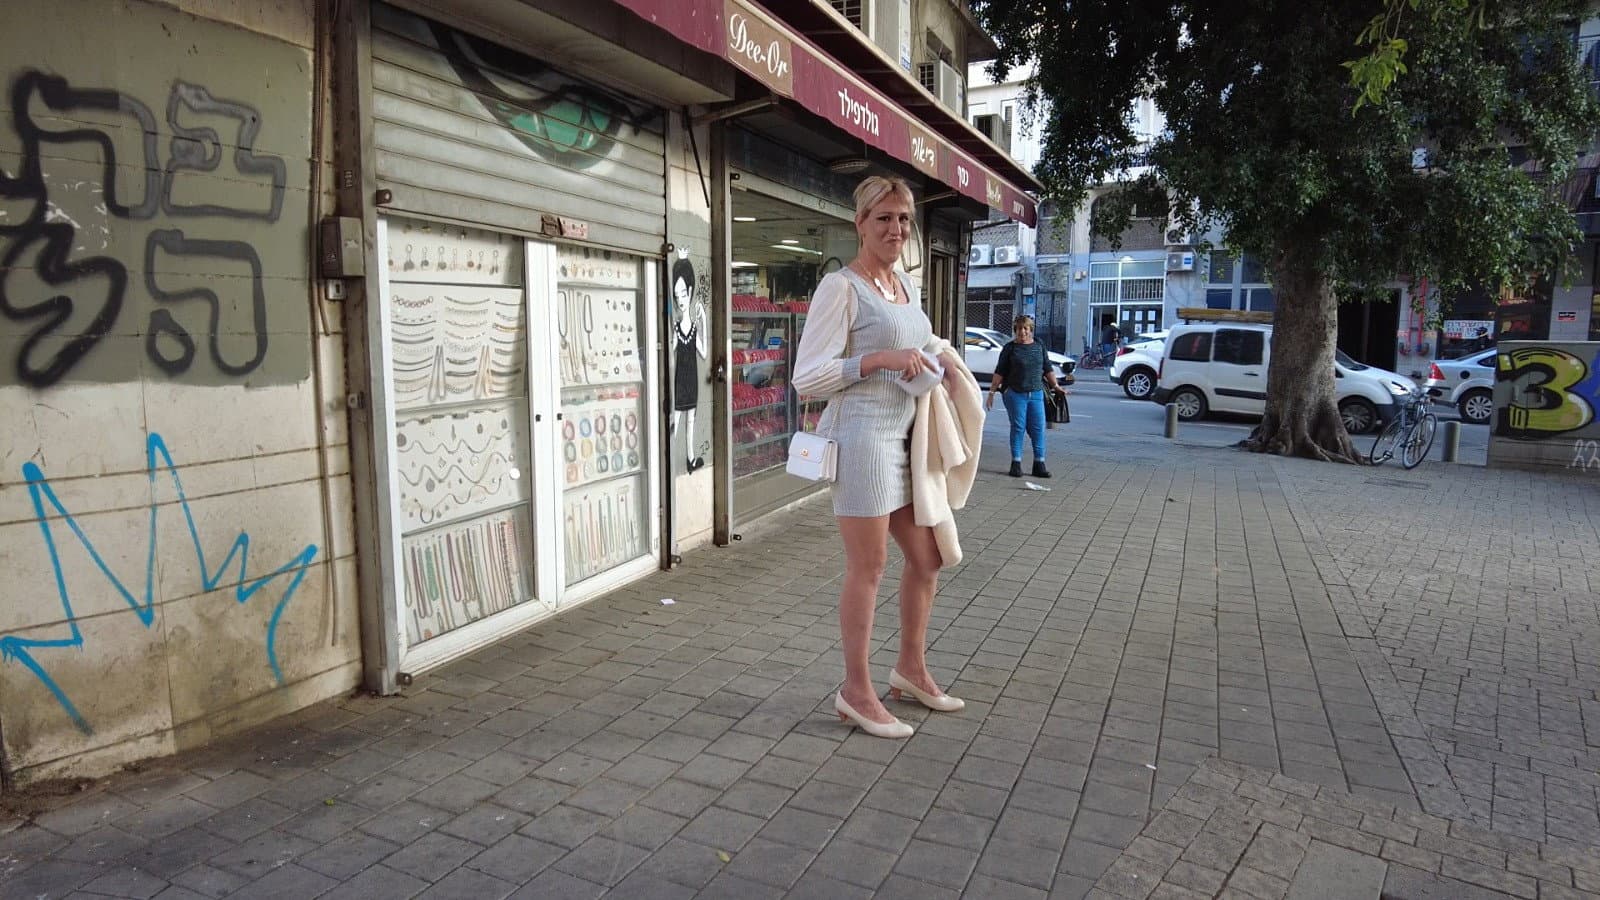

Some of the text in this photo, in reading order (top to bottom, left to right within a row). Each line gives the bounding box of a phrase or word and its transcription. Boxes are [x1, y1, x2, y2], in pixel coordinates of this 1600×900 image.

[729, 12, 789, 79] Dee-Or
[837, 87, 880, 137] גולדפילד
[956, 165, 970, 188] כסף
